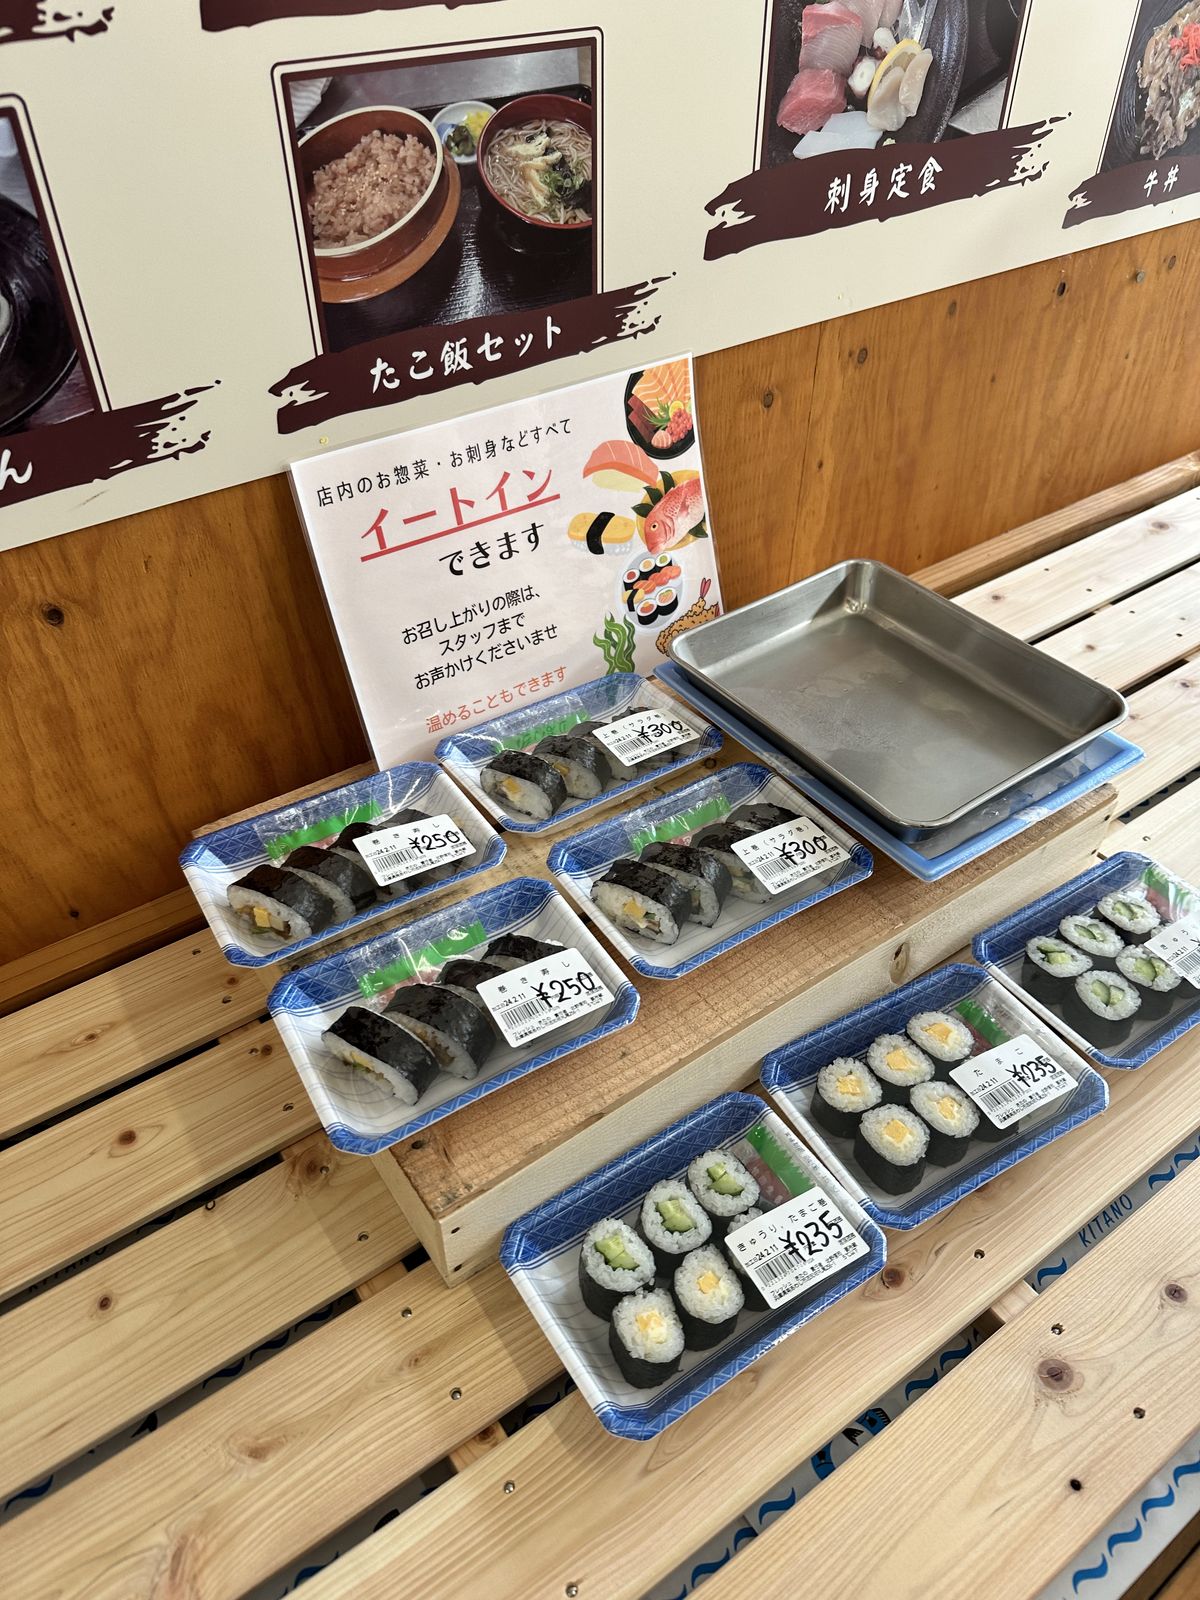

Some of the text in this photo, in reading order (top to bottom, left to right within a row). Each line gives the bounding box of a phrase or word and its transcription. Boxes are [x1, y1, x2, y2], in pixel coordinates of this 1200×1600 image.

[824, 157, 943, 213] 刺身定食
[1144, 164, 1179, 198] 牛丼
[369, 315, 562, 394] たこ飯セット
[317, 418, 571, 507] 店内のお惣菜・お刺身などすべて
[360, 467, 553, 550] イートイン
[439, 522, 545, 576] できます
[401, 584, 541, 645] お召し上がりの際は、
[438, 612, 526, 656] スタッフまで
[414, 623, 558, 690] お声かけくださいませ
[425, 665, 567, 734] 温めることもできます
[633, 720, 684, 743] ¥300
[408, 830, 461, 855] ¥250
[774, 836, 828, 866] ¥300
[530, 971, 596, 1008] ¥250
[1005, 1055, 1058, 1088] ¥235
[778, 1209, 844, 1263] ¥235
[1078, 1193, 1134, 1248] KITANO
